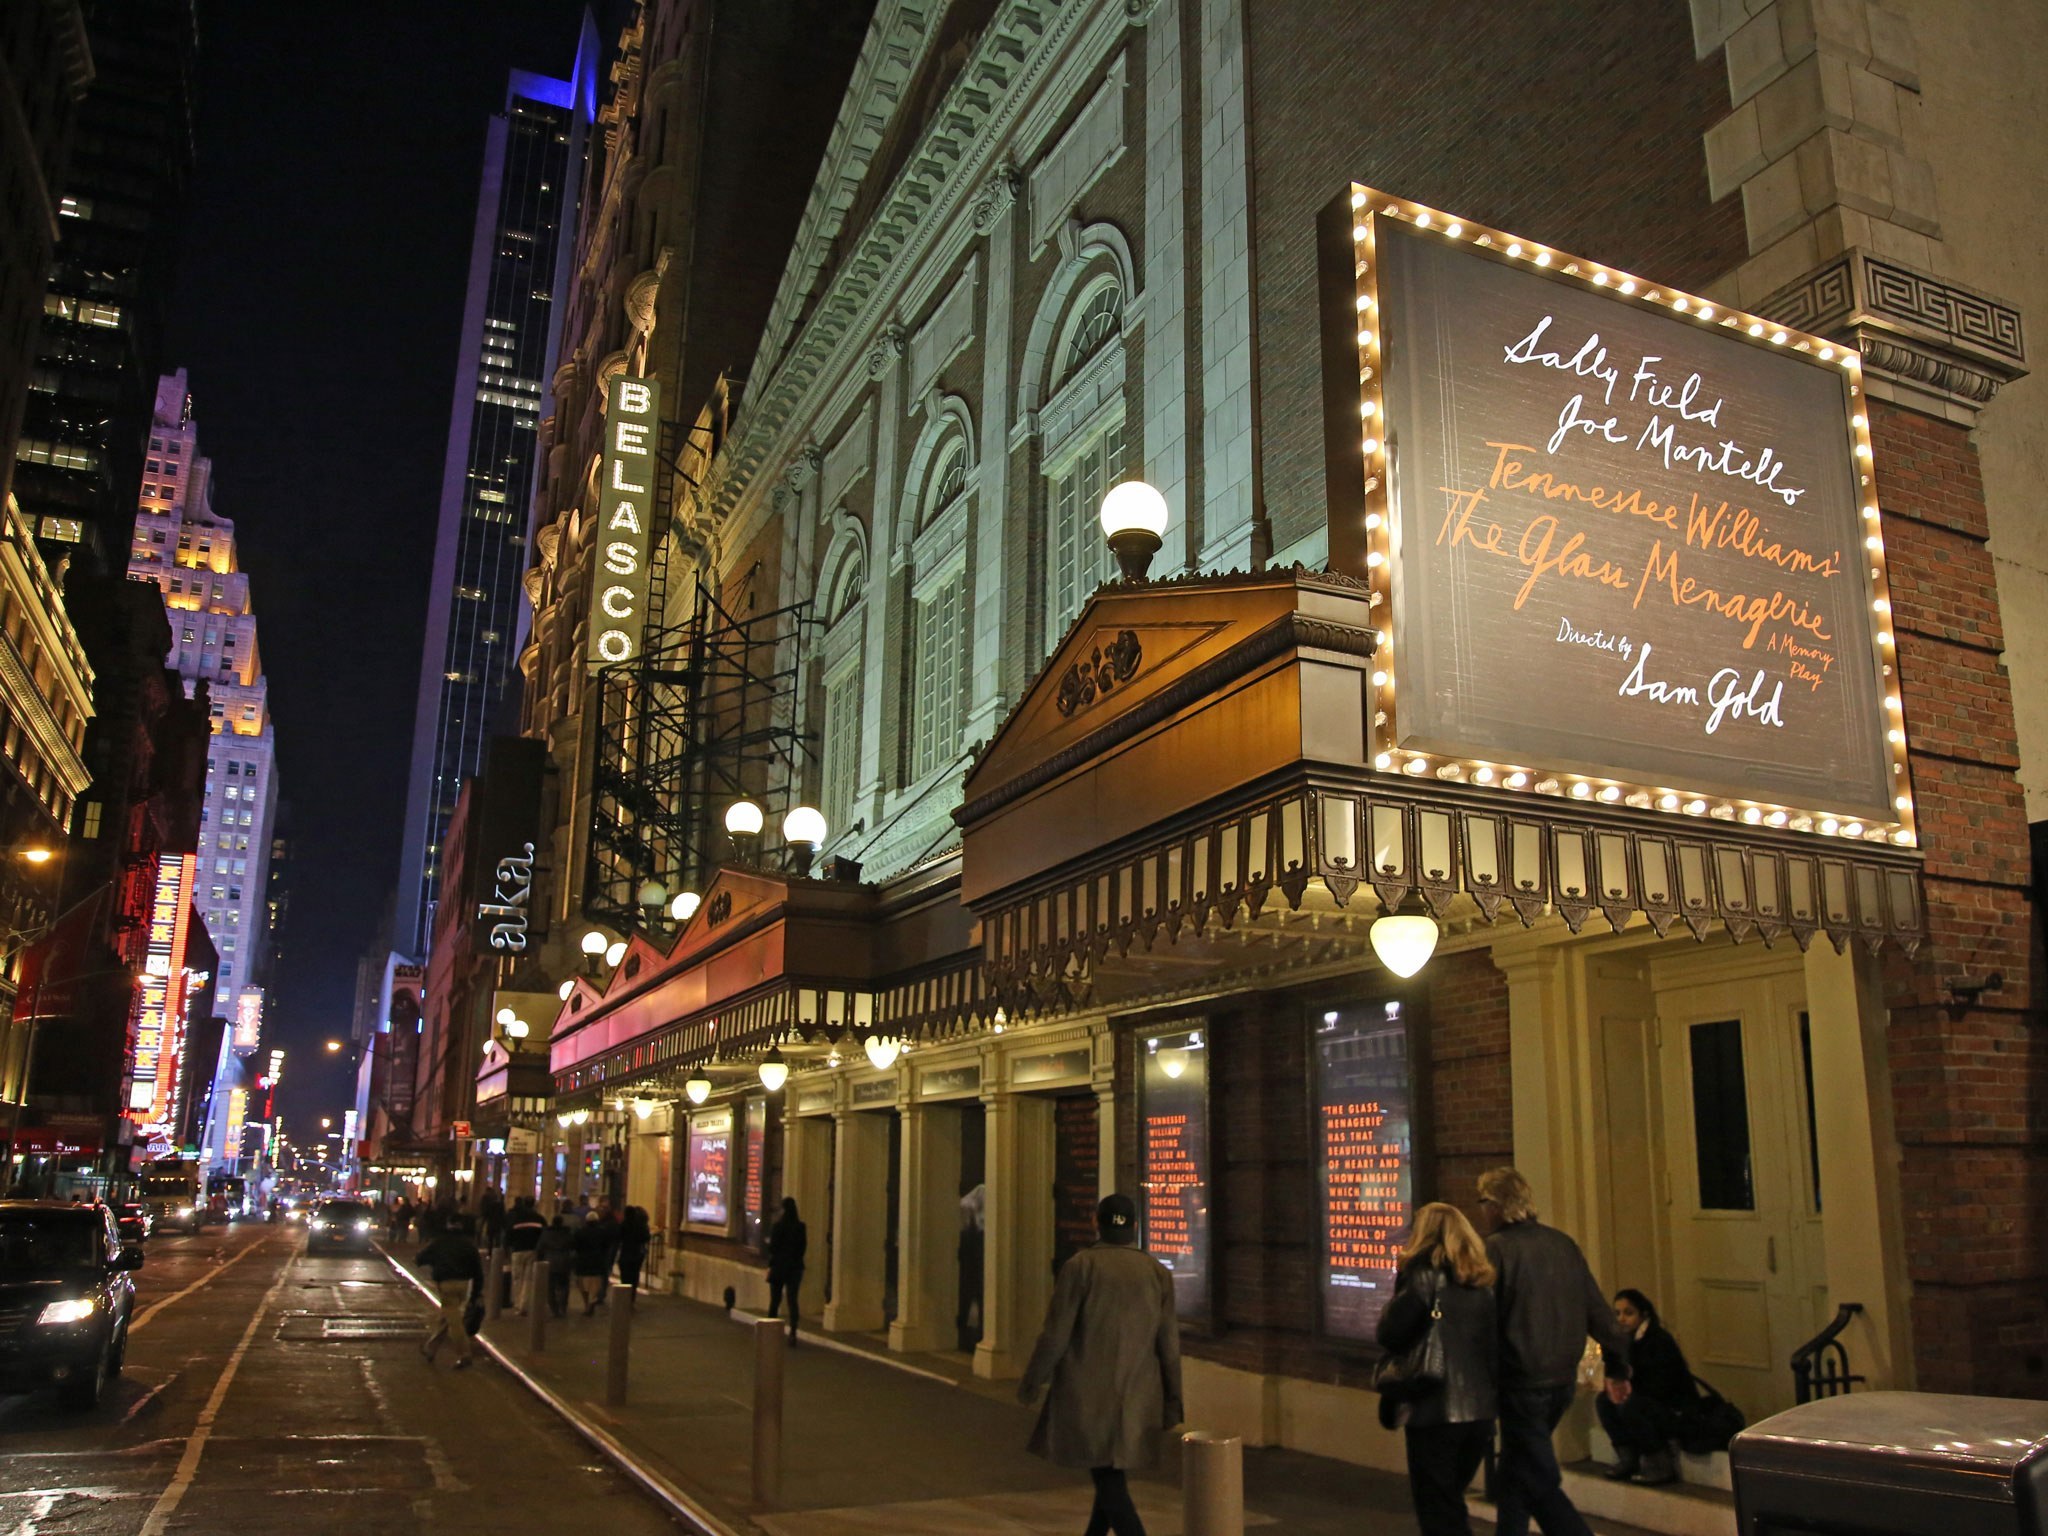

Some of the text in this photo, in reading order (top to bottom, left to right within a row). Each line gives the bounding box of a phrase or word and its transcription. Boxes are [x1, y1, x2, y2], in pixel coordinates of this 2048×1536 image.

[1504, 316, 1722, 428] Sally Field
[1547, 394, 1805, 505] Joe Mantello
[598, 381, 651, 662] BELASCO
[1486, 442, 1840, 578] Tennessee Williams'
[1436, 486, 1832, 649] The Glass Menagerie
[1556, 616, 1632, 661] Directed by
[1767, 632, 1834, 672] A Memory
[1619, 642, 1784, 735] Sam Gold
[1790, 661, 1823, 692] Play
[151, 865, 181, 942] PARK
[136, 989, 163, 1066] PARK
[1348, 1102, 1379, 1114] GLASS
[1327, 1131, 1373, 1142] HAS THAT
[1328, 1144, 1399, 1156] BEAUTIFUL MIX
[1328, 1158, 1400, 1169] OF HEART AND
[1329, 1172, 1399, 1183] SHOWMANSHIP
[1329, 1187, 1397, 1197] WHICH MAKES
[1329, 1201, 1403, 1212] NEW YORK THE
[1329, 1214, 1403, 1226] UNCHALLENGED
[1329, 1228, 1386, 1240] CAPITAL OF
[1330, 1242, 1347, 1252] THE
[1352, 1243, 1386, 1254] WORLD
